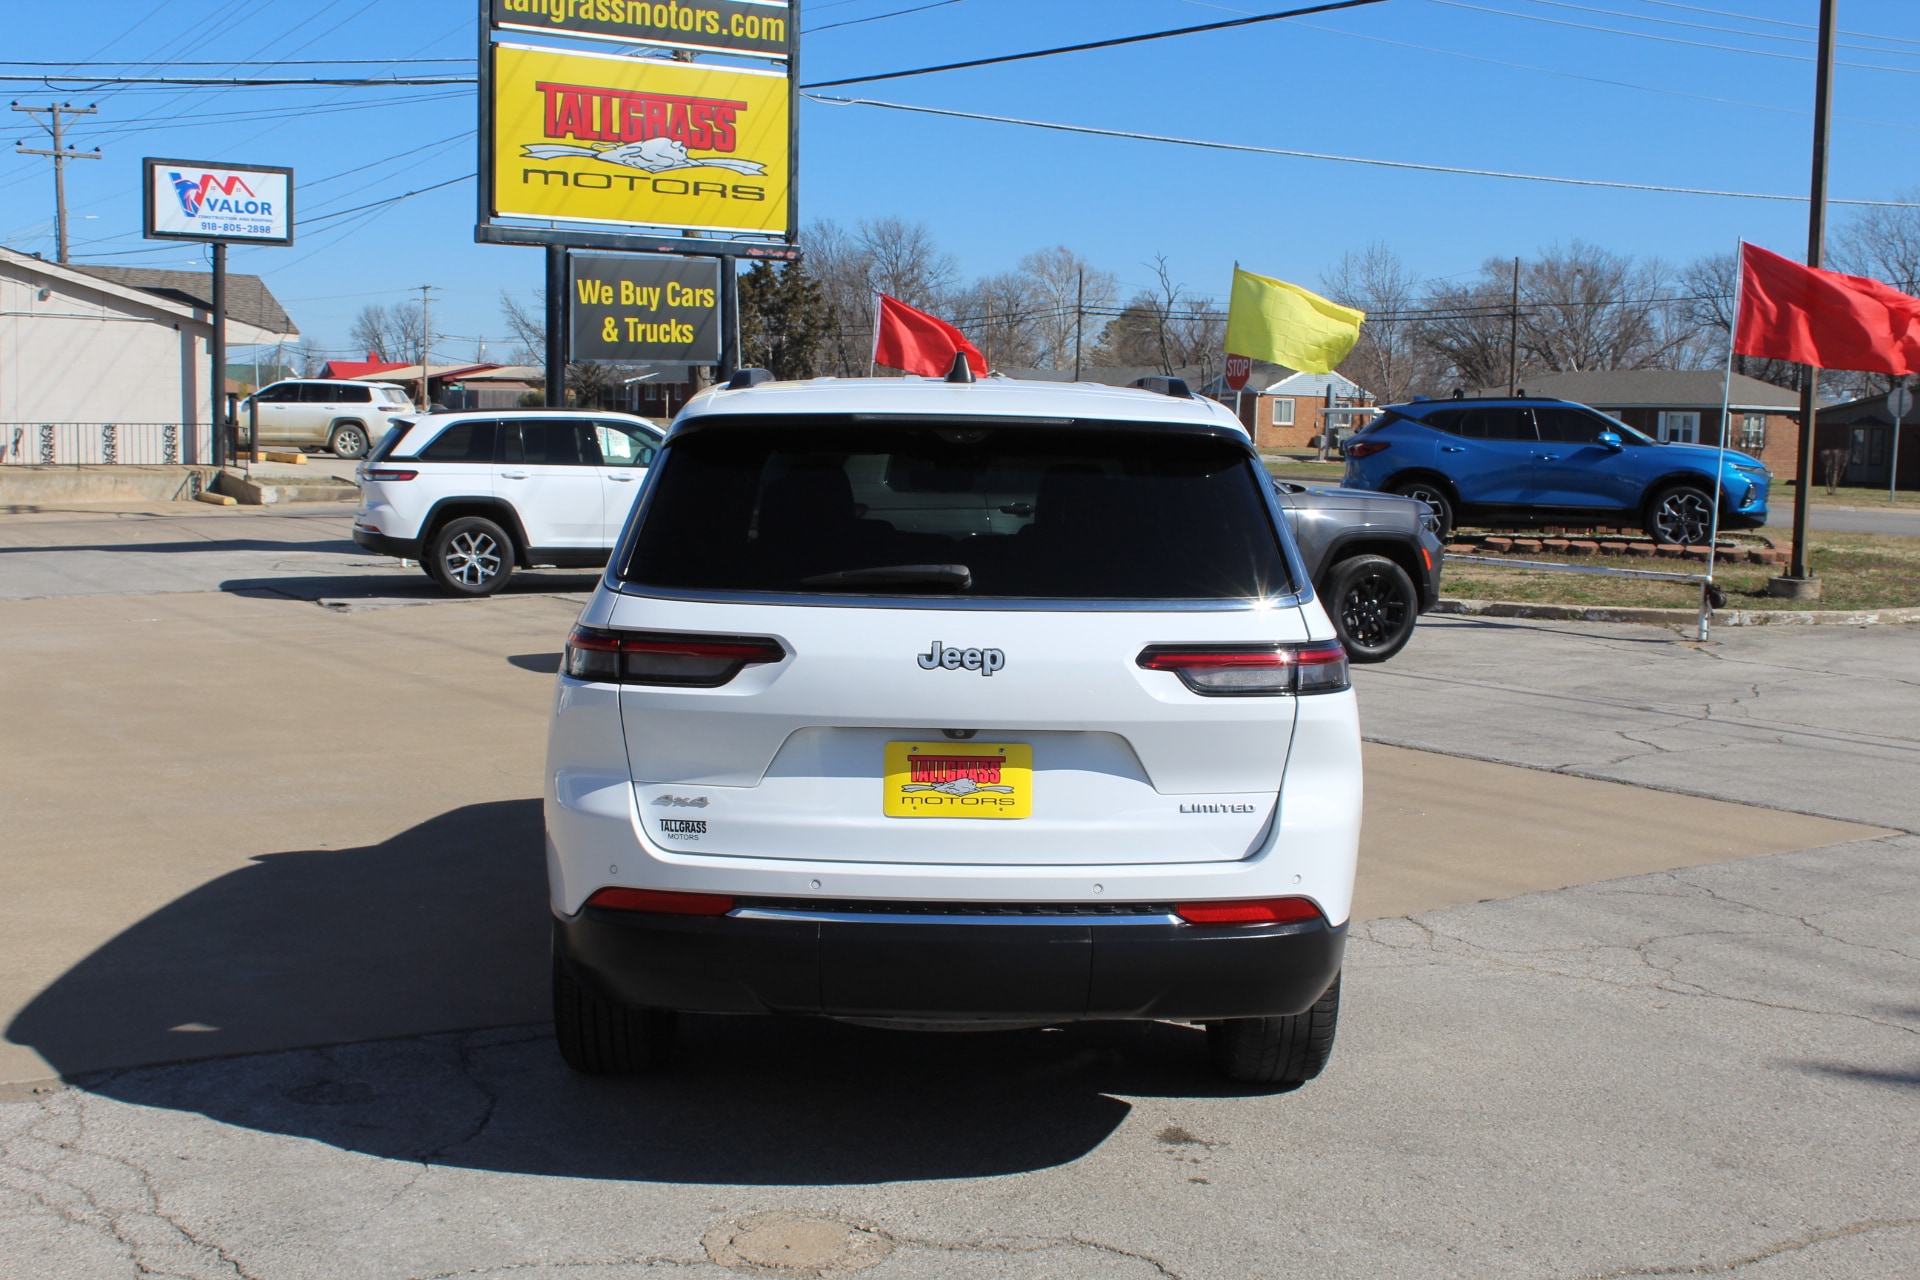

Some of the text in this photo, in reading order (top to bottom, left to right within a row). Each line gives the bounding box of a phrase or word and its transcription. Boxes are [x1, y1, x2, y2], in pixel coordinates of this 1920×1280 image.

[535, 81, 747, 152] TALLGRASS
[205, 197, 273, 216] VALOR
[201, 221, 271, 234] 918-805-2898
[577, 279, 715, 312] We Buy Cars
[602, 316, 694, 344] & Trucks
[1227, 359, 1248, 377] STOP
[917, 641, 1005, 677] Jeep
[907, 755, 1006, 784] TALLGRASS
[1179, 803, 1256, 814] LIMITED
[659, 819, 707, 833] TALLGRASS
[668, 833, 699, 841] MOTORS
